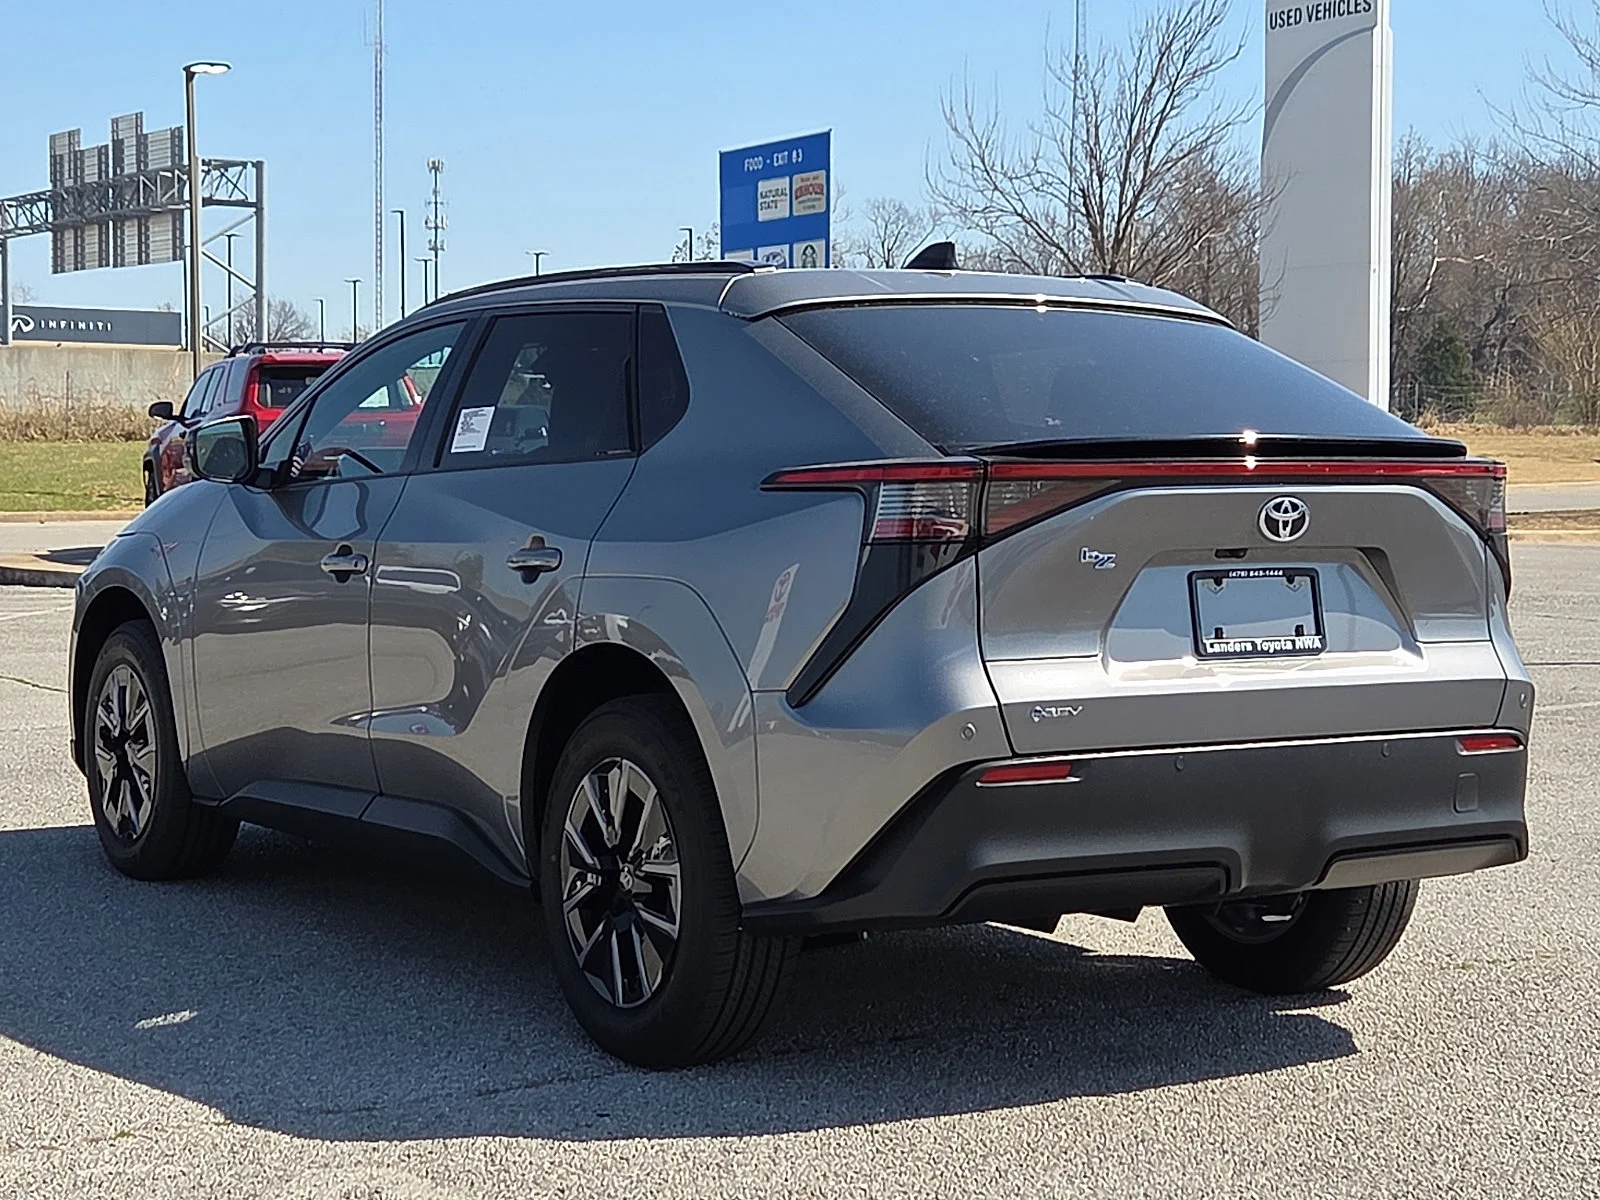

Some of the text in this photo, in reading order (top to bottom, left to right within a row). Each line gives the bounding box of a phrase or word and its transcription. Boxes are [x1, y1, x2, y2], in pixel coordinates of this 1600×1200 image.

[1269, 0, 1372, 30] USED VEHICLES
[744, 156, 763, 172] FOOD
[773, 151, 788, 167] EXIT
[759, 187, 788, 199] NATURAL
[759, 199, 778, 211] STATE
[40, 319, 112, 332] INFINITI
[1205, 636, 1322, 654] Landers Toyota NWA
